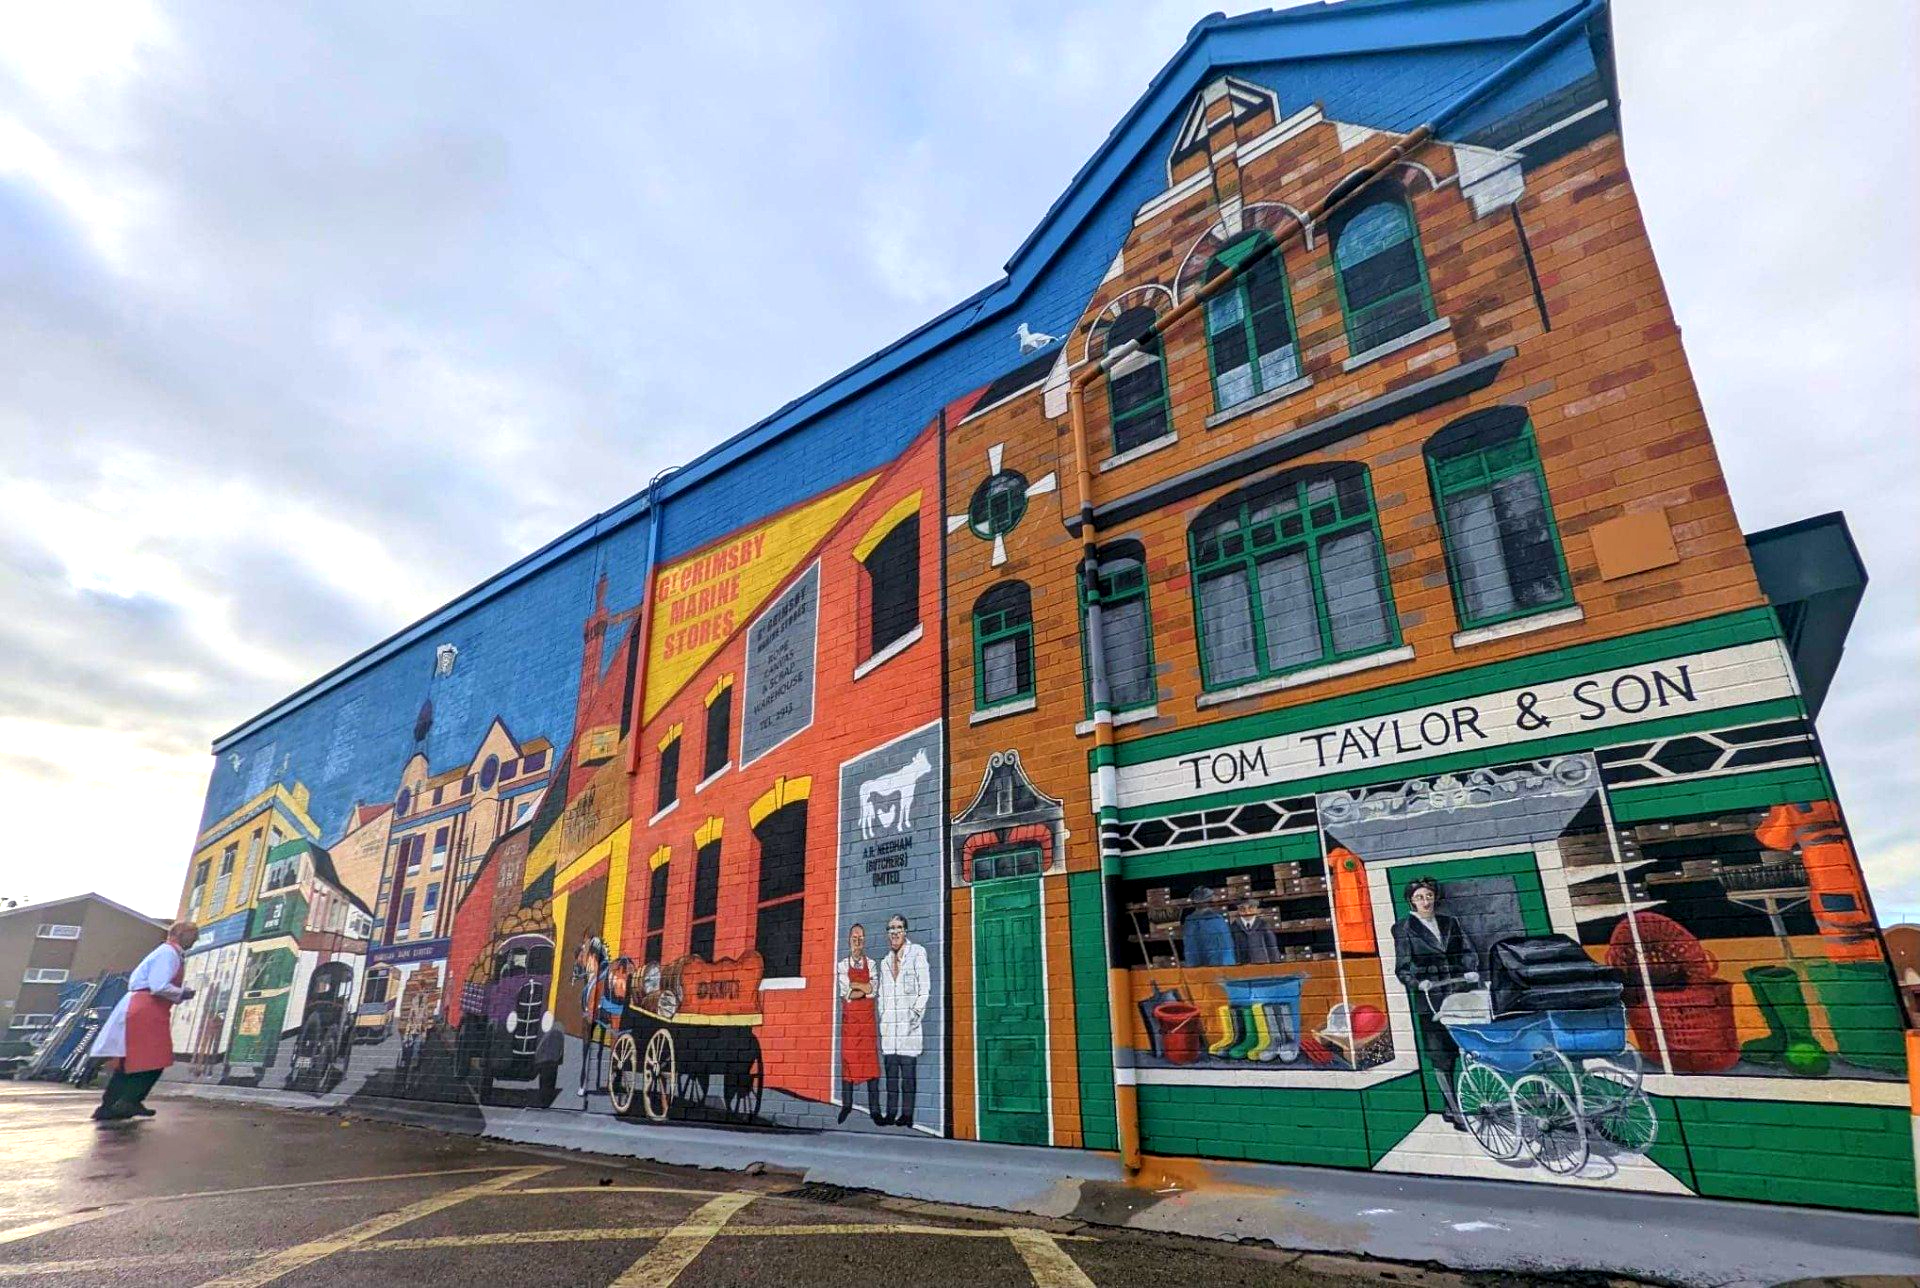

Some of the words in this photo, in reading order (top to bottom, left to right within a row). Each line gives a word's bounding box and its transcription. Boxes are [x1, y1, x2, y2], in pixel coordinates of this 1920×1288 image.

[680, 532, 766, 592] GRIMSBY
[669, 573, 740, 627] MARINE
[663, 608, 734, 660] STORES
[767, 640, 789, 664] ROPE
[764, 651, 794, 678] CANVAS
[769, 662, 796, 690] SCRAP
[753, 671, 804, 715] WAREHOUSE
[1179, 745, 1269, 790] TOM
[1299, 706, 1488, 768] TAYLOR
[1515, 690, 1552, 731] &
[1572, 664, 1698, 721] SON
